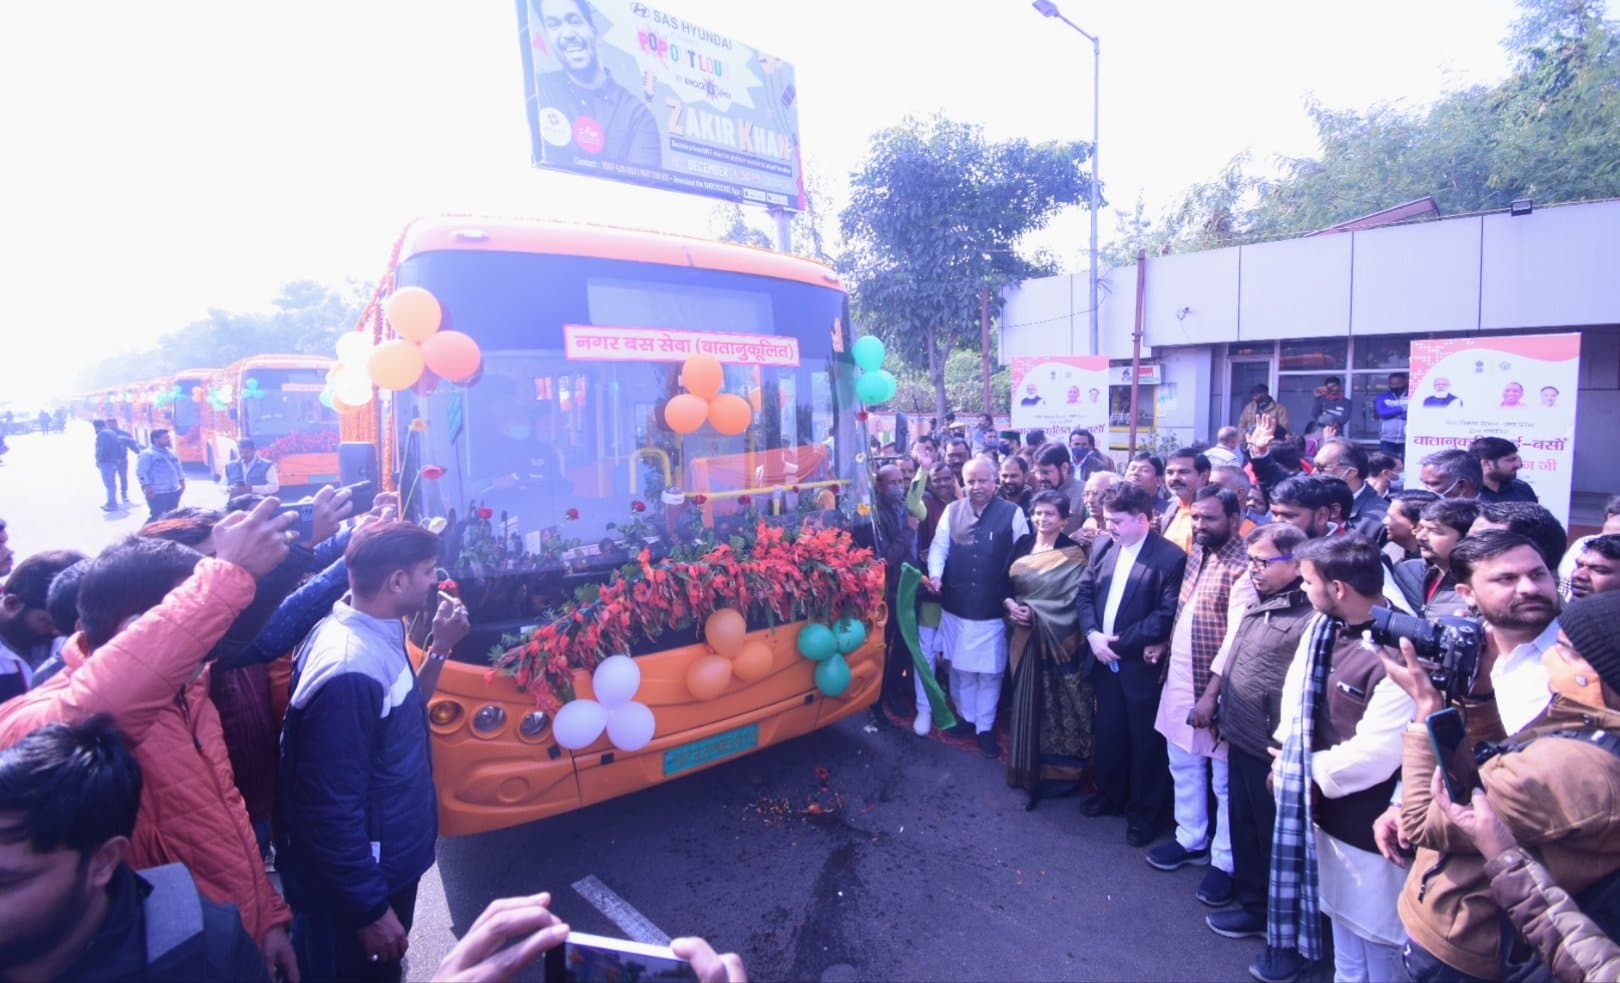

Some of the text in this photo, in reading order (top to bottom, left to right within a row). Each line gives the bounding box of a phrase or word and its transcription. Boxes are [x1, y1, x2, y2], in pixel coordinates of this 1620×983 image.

[652, 8, 733, 51] SAS HYUNDAI
[669, 43, 696, 69] OT
[664, 98, 792, 160] ZAKIR KHAN
[574, 335, 621, 350] नगर
[623, 336, 654, 352] बस
[657, 333, 691, 353] सेवा
